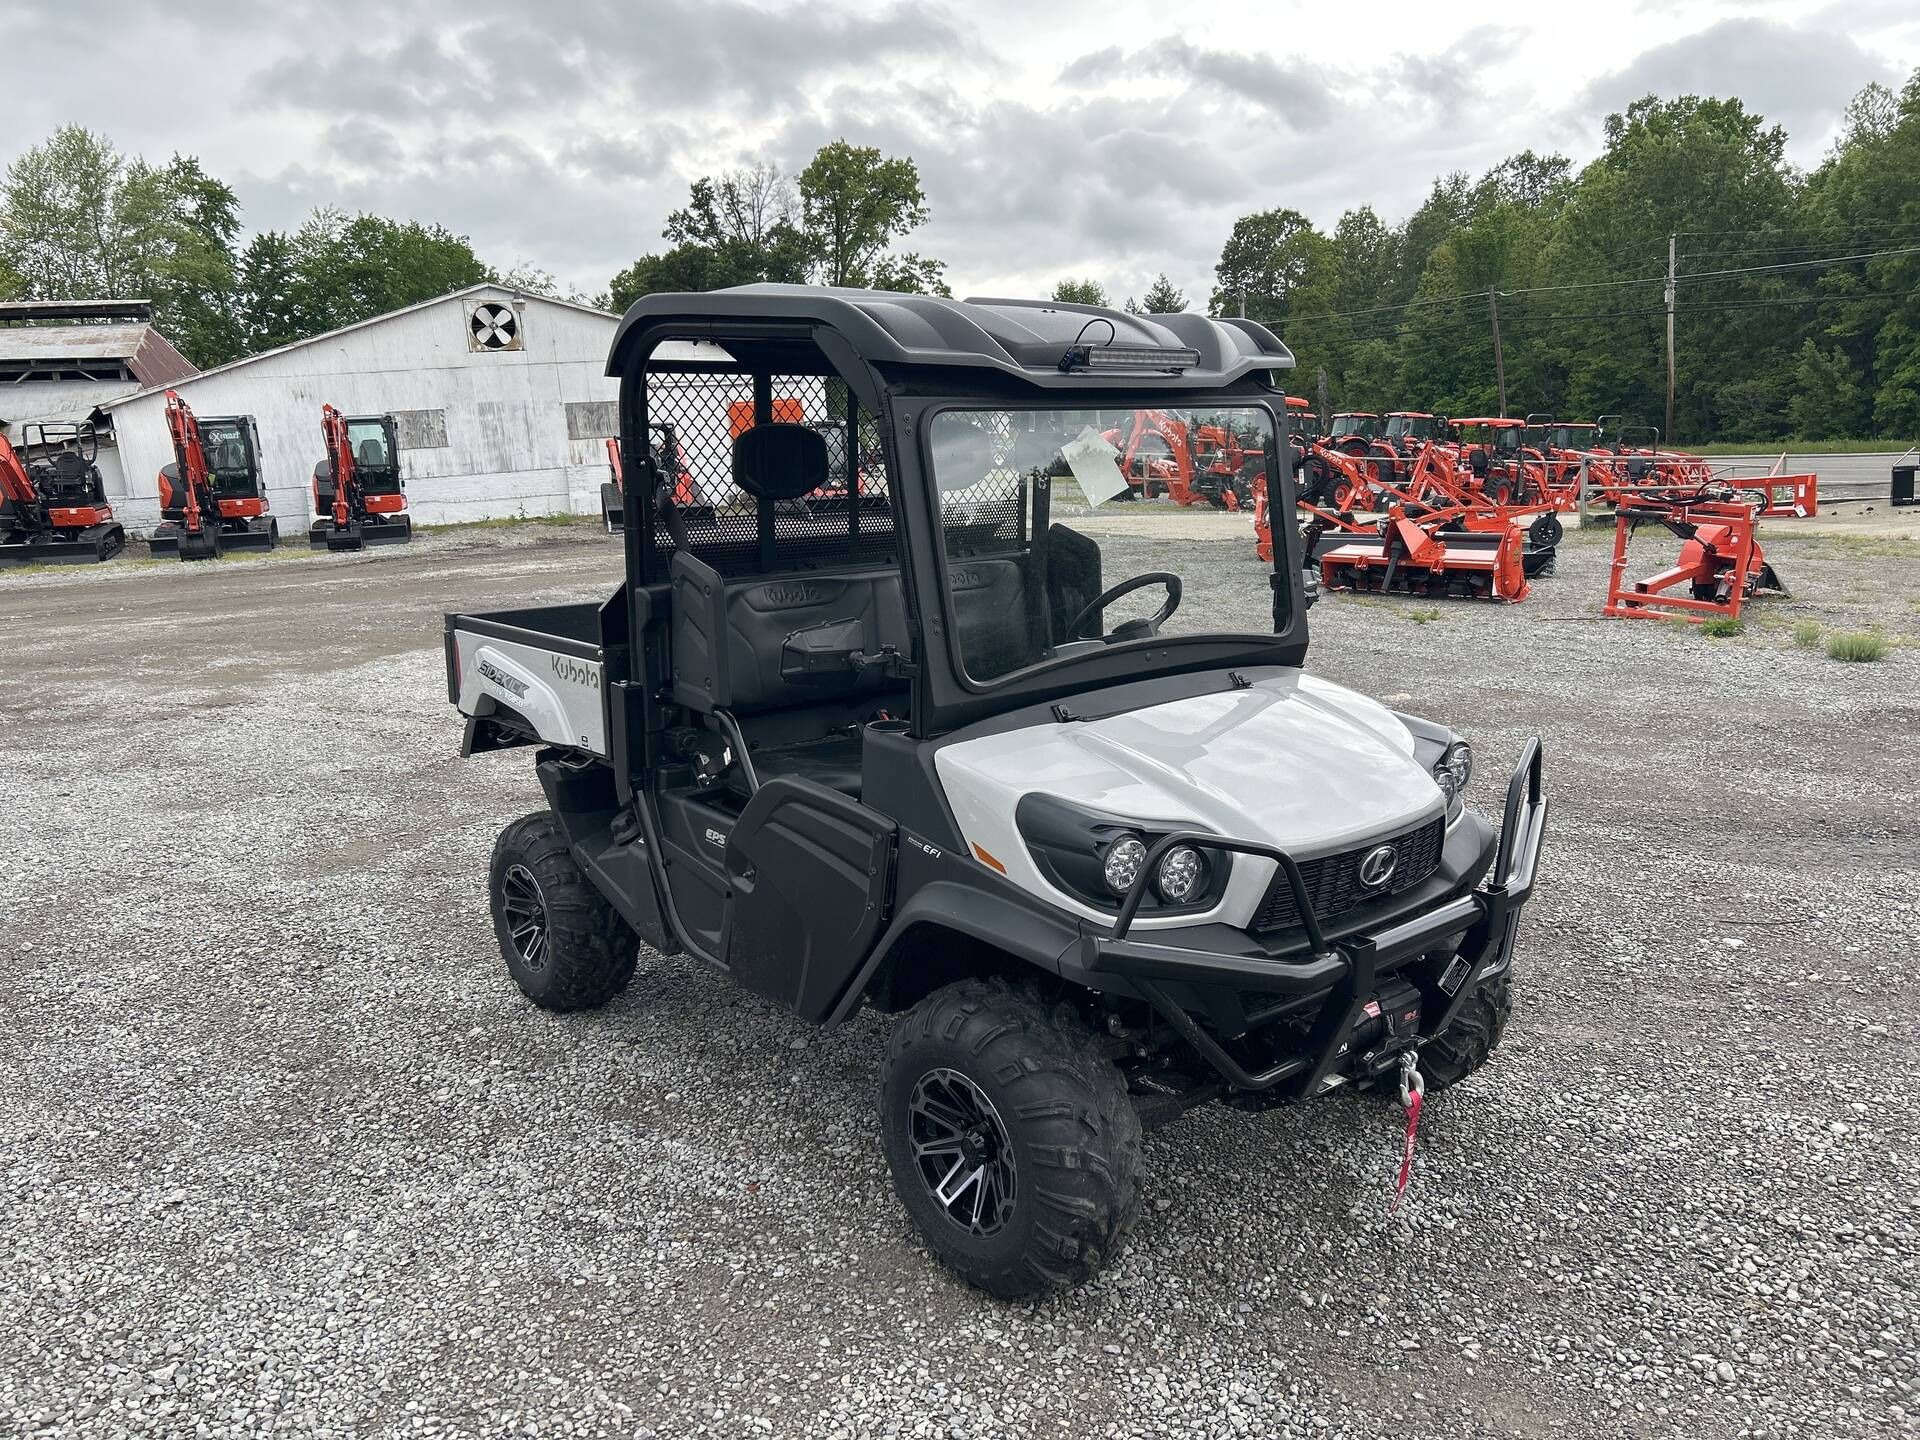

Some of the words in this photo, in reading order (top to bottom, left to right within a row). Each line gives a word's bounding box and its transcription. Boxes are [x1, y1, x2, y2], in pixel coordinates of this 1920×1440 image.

[1159, 420, 1182, 446] Kubota
[477, 660, 530, 700] SIDEKICK
[551, 654, 599, 689] Kubota
[705, 828, 727, 845] EPS
[922, 844, 942, 859] EFI
